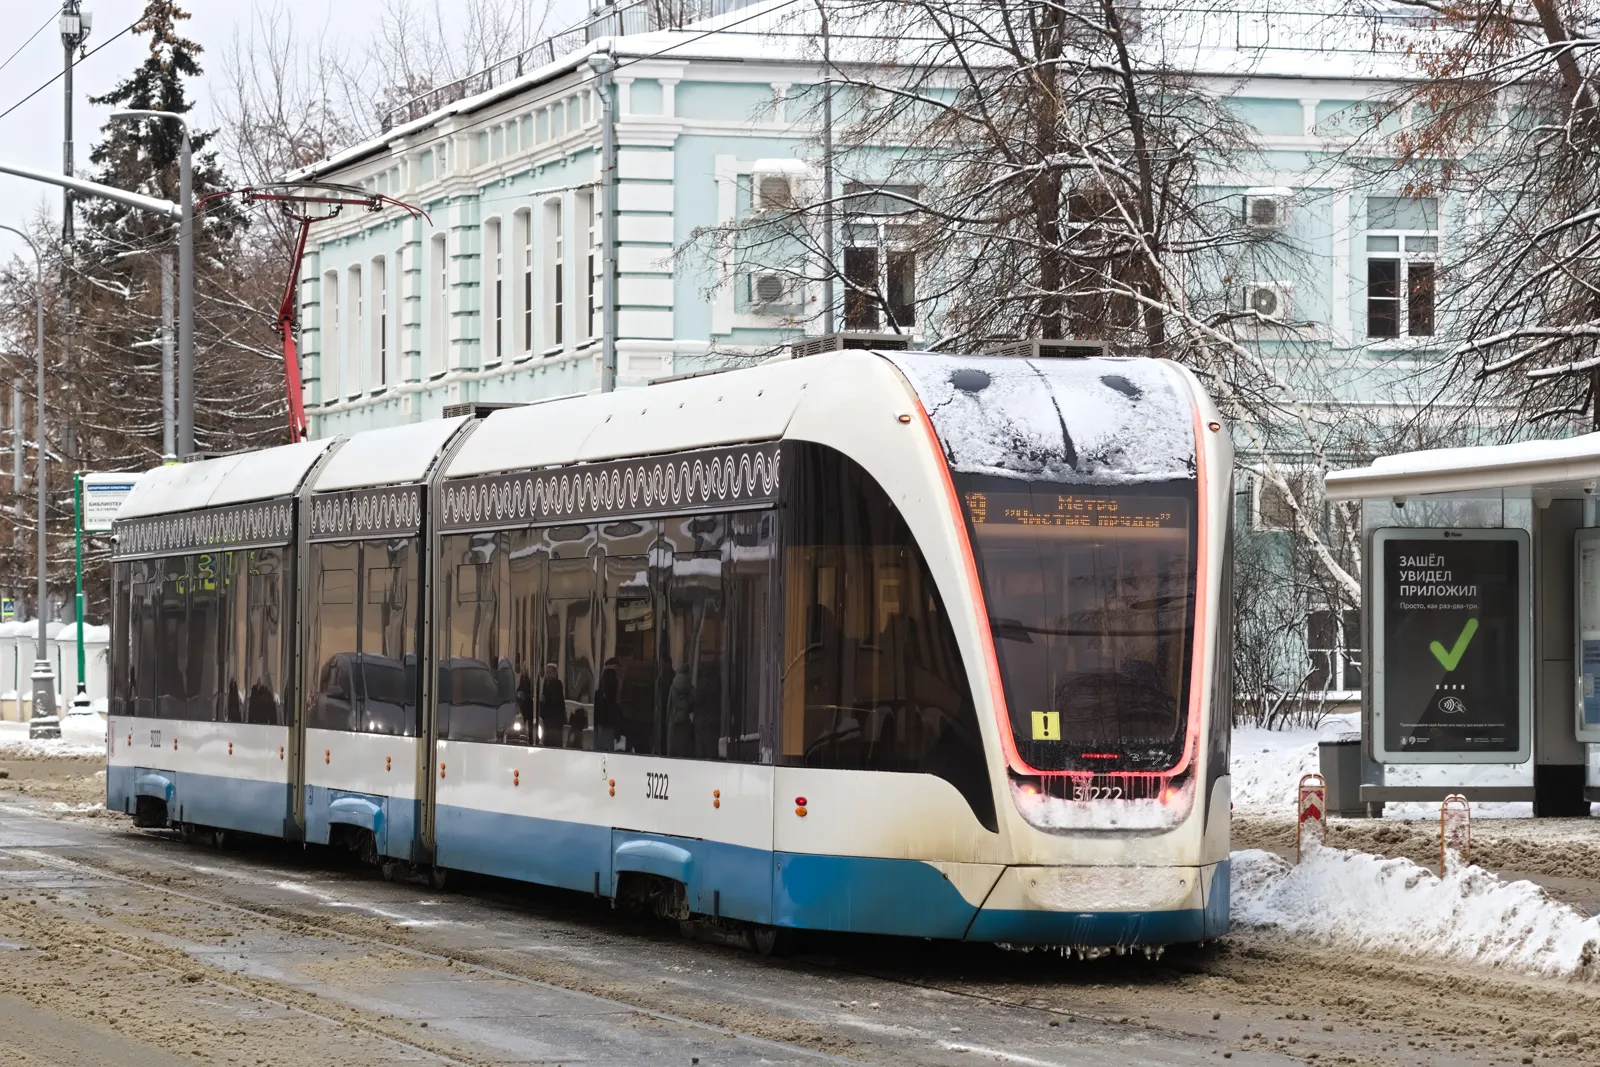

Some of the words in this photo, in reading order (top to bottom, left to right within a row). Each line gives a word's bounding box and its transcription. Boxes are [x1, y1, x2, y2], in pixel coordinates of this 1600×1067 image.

[1059, 496, 1118, 510] Метро
[1399, 553, 1445, 567] ЗАШЁЛ
[1399, 570, 1452, 583] УВИДЕЛ
[1400, 585, 1477, 597] ПРИЛОЖИЛ
[1400, 602, 1426, 611] Просто,
[646, 772, 669, 800] 31222
